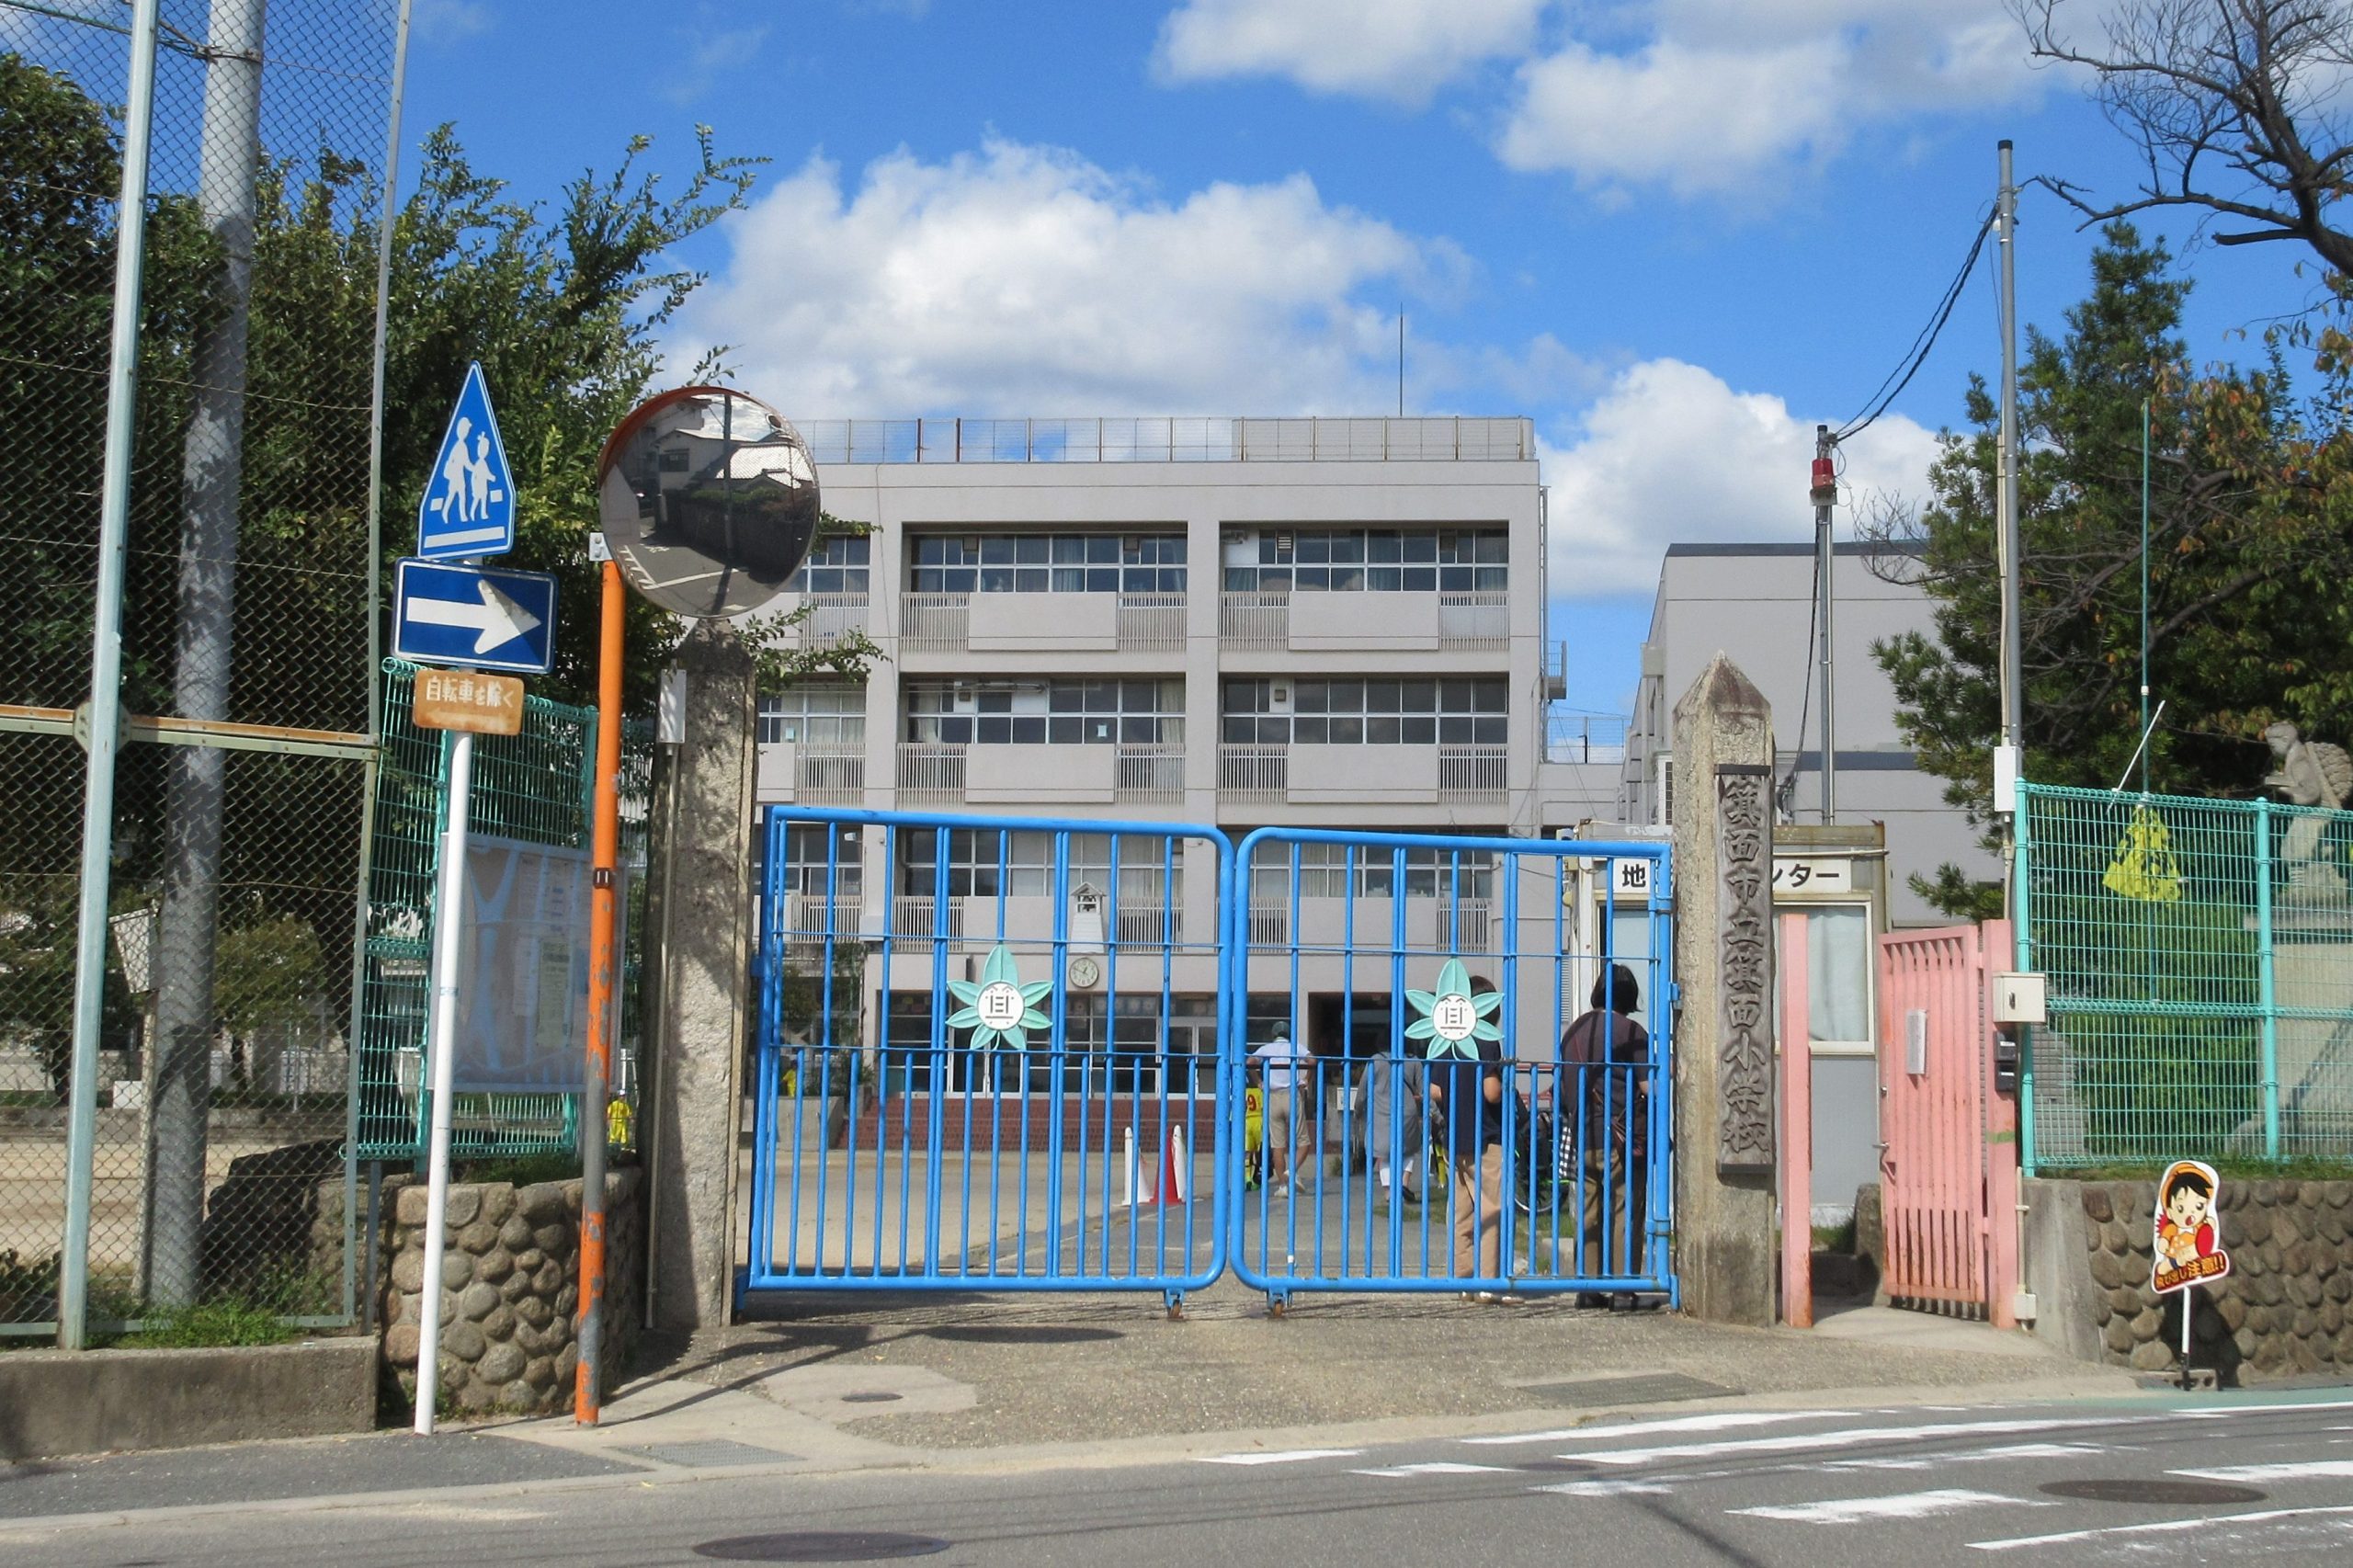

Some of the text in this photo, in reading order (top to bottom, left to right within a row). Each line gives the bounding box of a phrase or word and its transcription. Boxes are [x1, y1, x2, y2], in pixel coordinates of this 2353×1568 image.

[426, 676, 515, 708] 自転車を除く
[1621, 863, 1647, 888] 地
[1722, 782, 1769, 1153] 箕面市立箕面小学校
